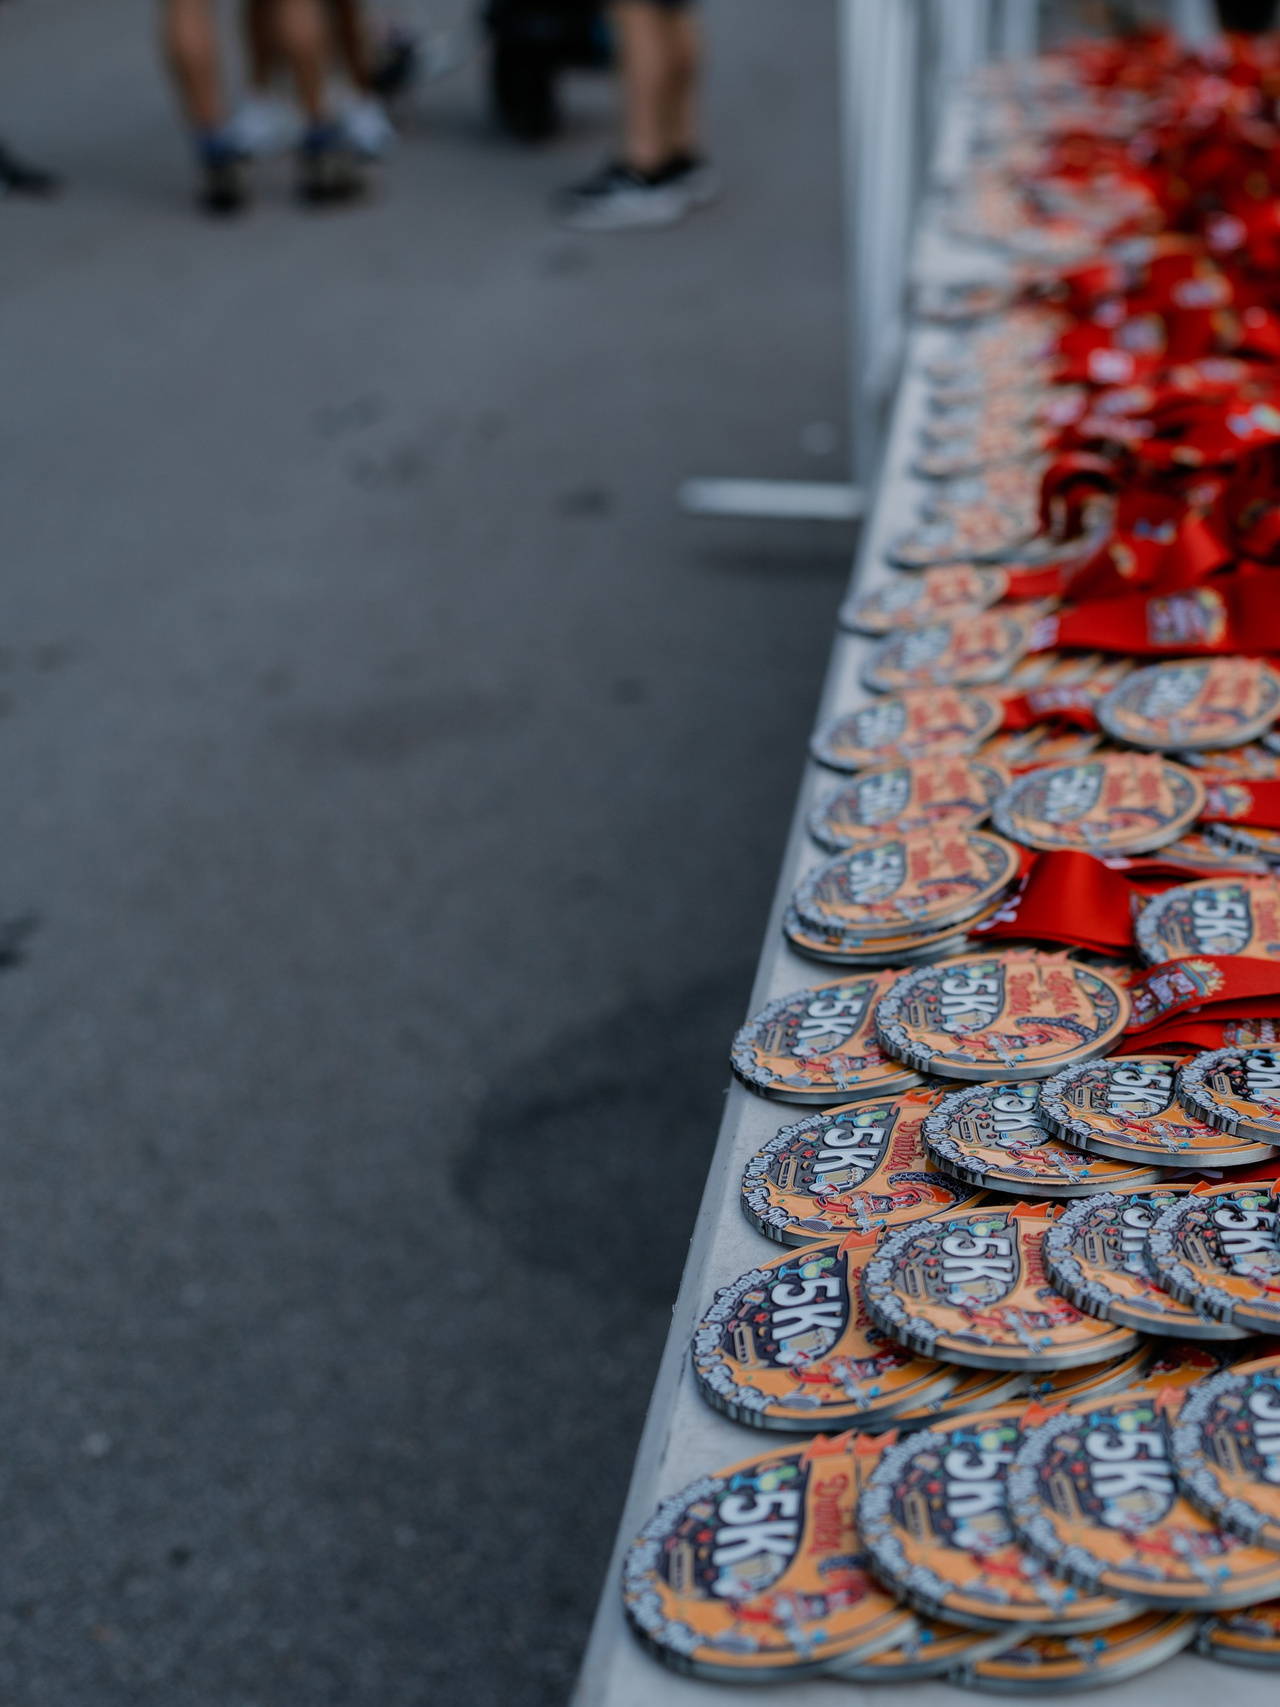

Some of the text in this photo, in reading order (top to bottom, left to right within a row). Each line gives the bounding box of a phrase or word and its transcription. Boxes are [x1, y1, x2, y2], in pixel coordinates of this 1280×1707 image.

[1192, 900, 1249, 938] 5K
[795, 1001, 864, 1039] 5K
[941, 978, 999, 1016] 5K
[1106, 1071, 1172, 1106] 5K
[813, 1128, 886, 1174] 5K
[883, 1118, 925, 1174] Drinko
[942, 1236, 1013, 1283] 5K
[771, 1277, 843, 1340] 5K
[1086, 1430, 1175, 1499] 5K
[711, 1490, 799, 1568] 5K
